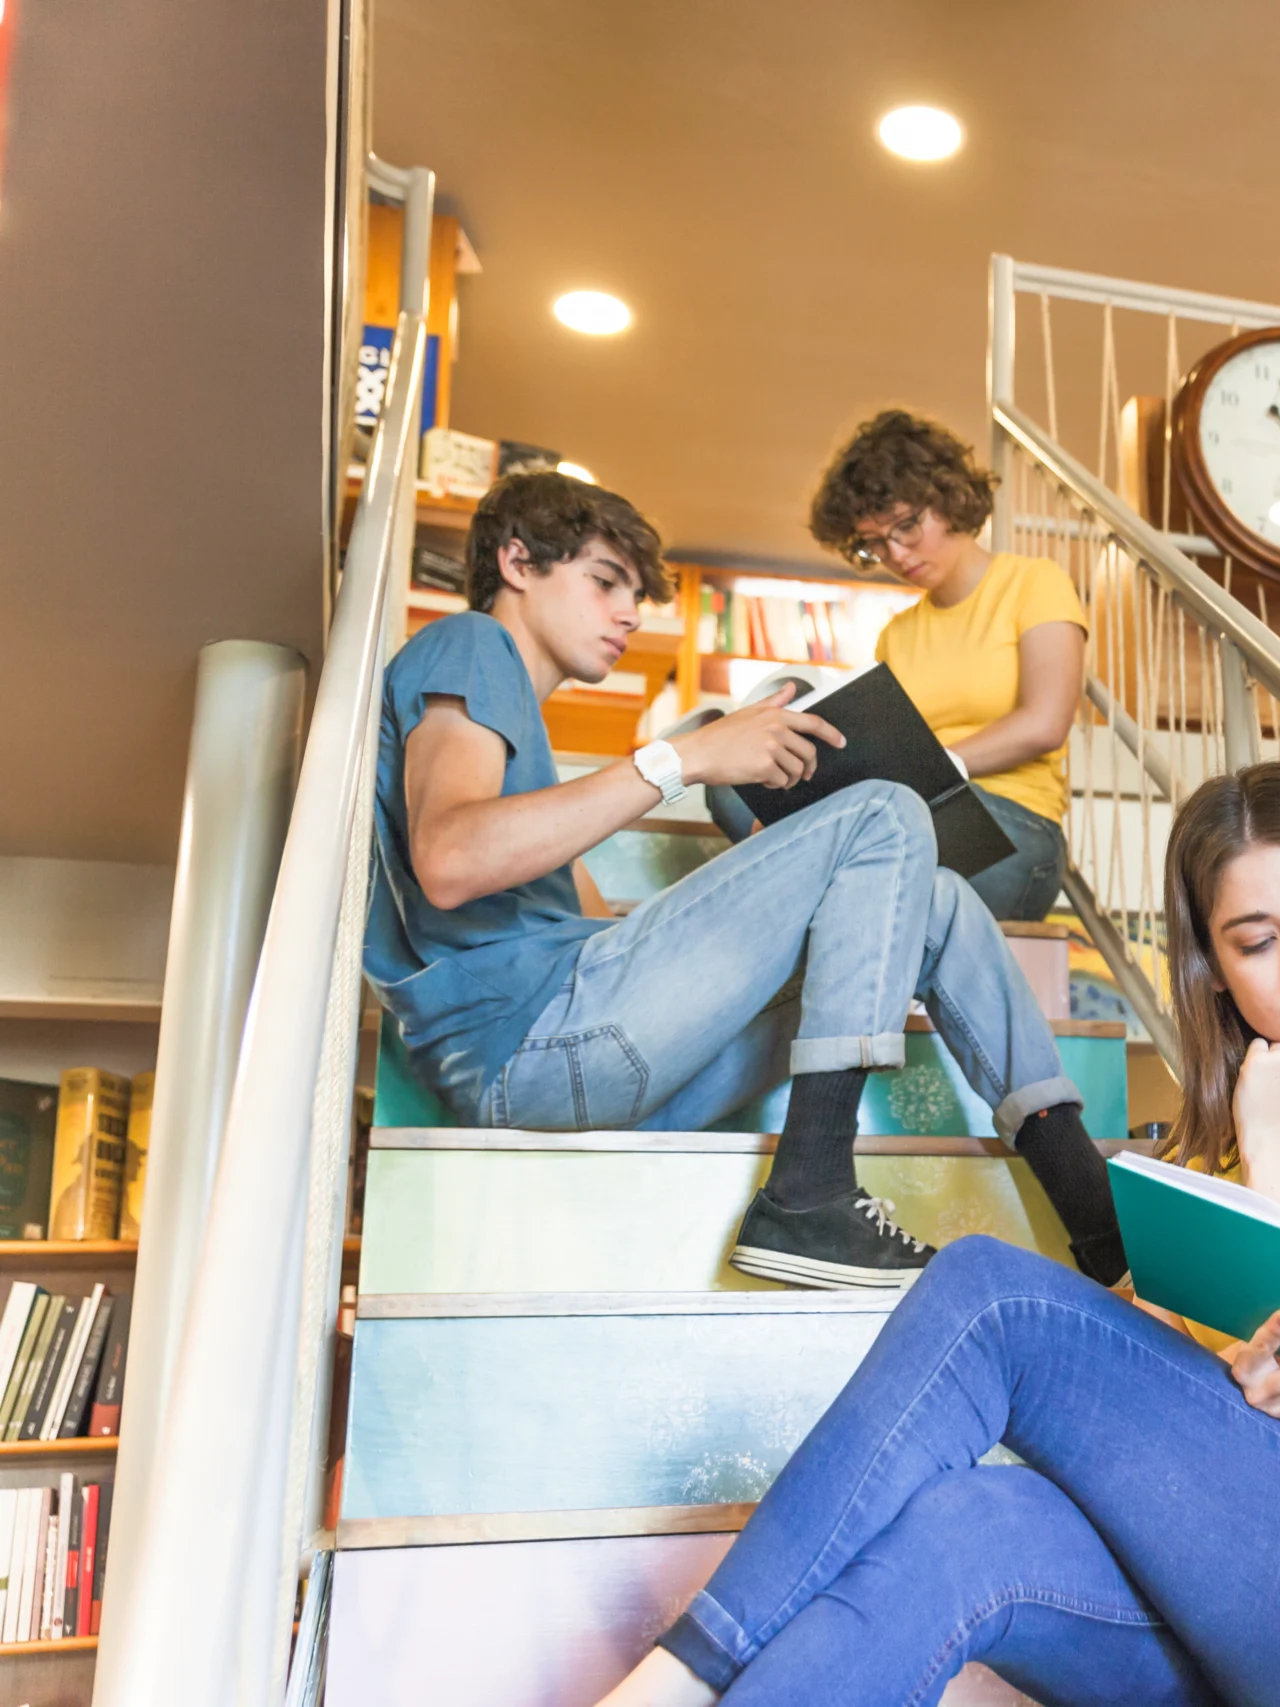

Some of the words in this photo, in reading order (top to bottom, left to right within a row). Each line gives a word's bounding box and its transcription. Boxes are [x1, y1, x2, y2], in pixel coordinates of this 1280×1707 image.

[1255, 363, 1270, 381] 11
[1221, 390, 1240, 407] 10
[1208, 431, 1220, 447] 9
[1222, 477, 1233, 495] 8
[1257, 516, 1266, 533] 7
